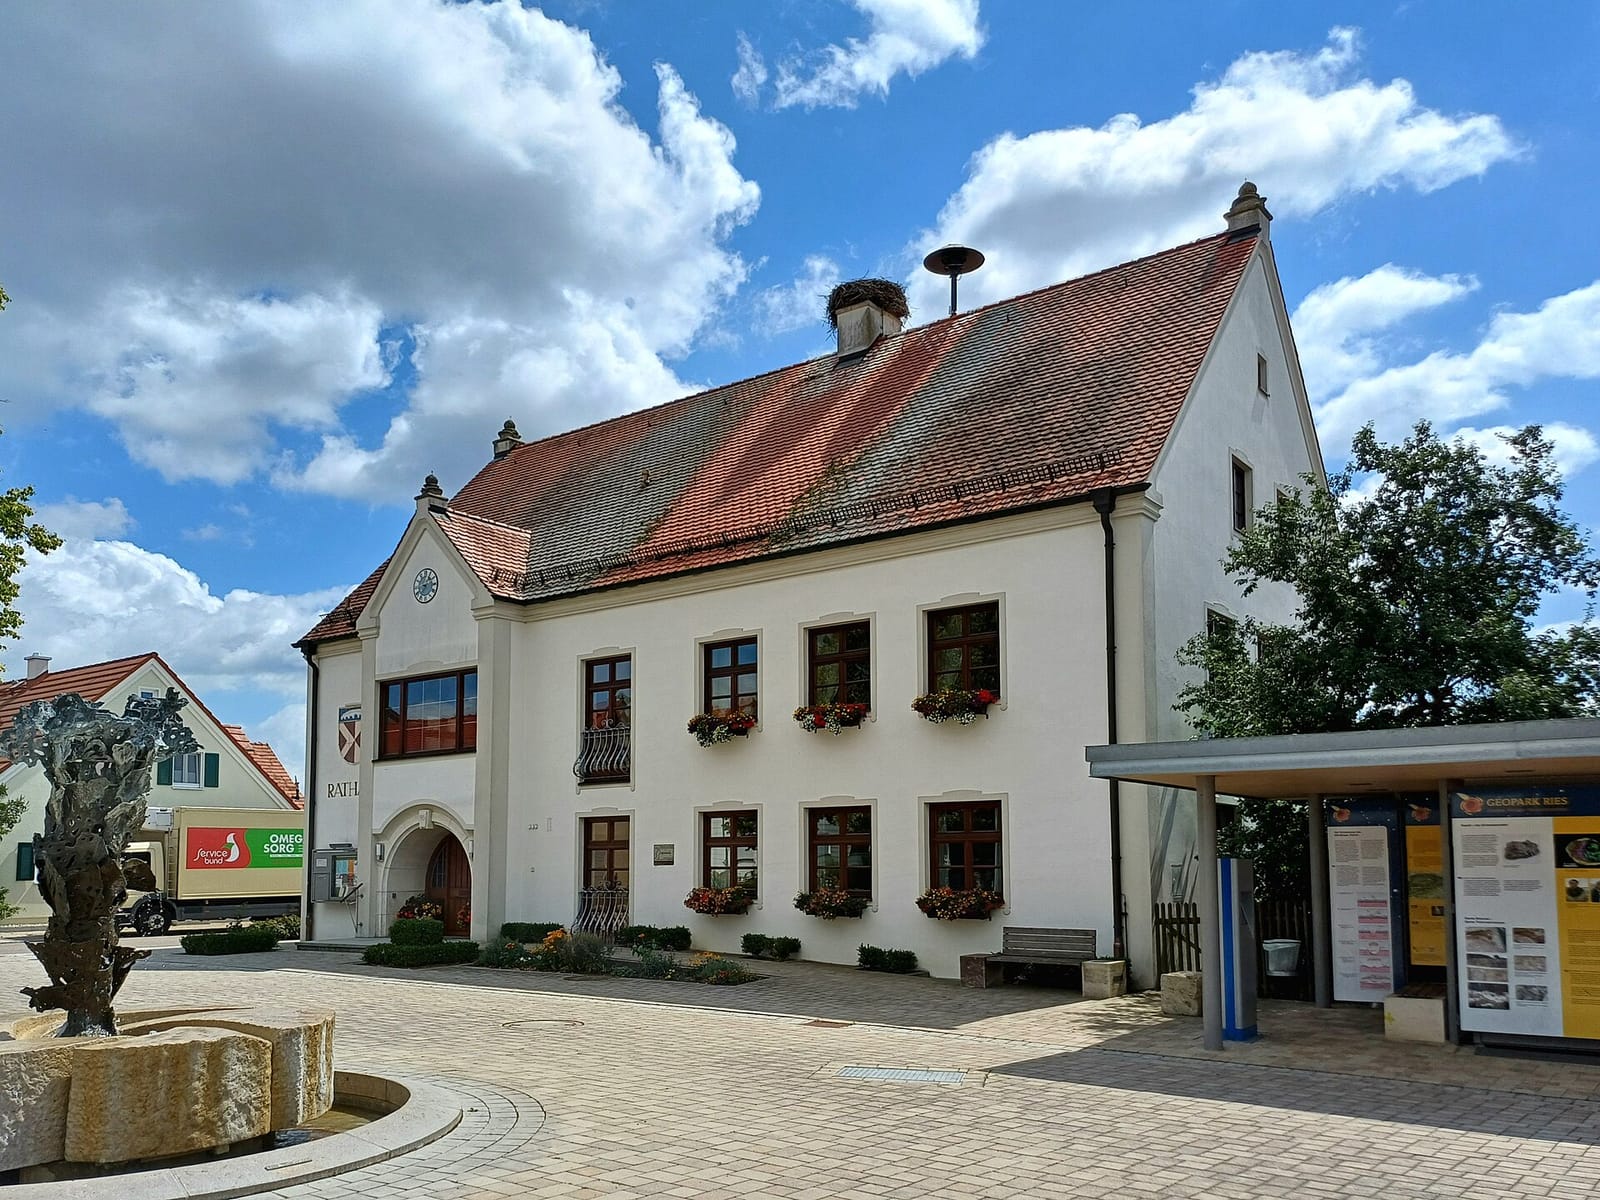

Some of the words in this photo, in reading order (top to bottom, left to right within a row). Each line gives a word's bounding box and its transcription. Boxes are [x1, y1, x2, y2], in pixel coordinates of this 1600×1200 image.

[328, 781, 360, 798] RATH
[1486, 797, 1541, 807] GEOPARK
[1543, 796, 1569, 806] RIES
[263, 843, 295, 854] SORG
[204, 857, 224, 865] bund
